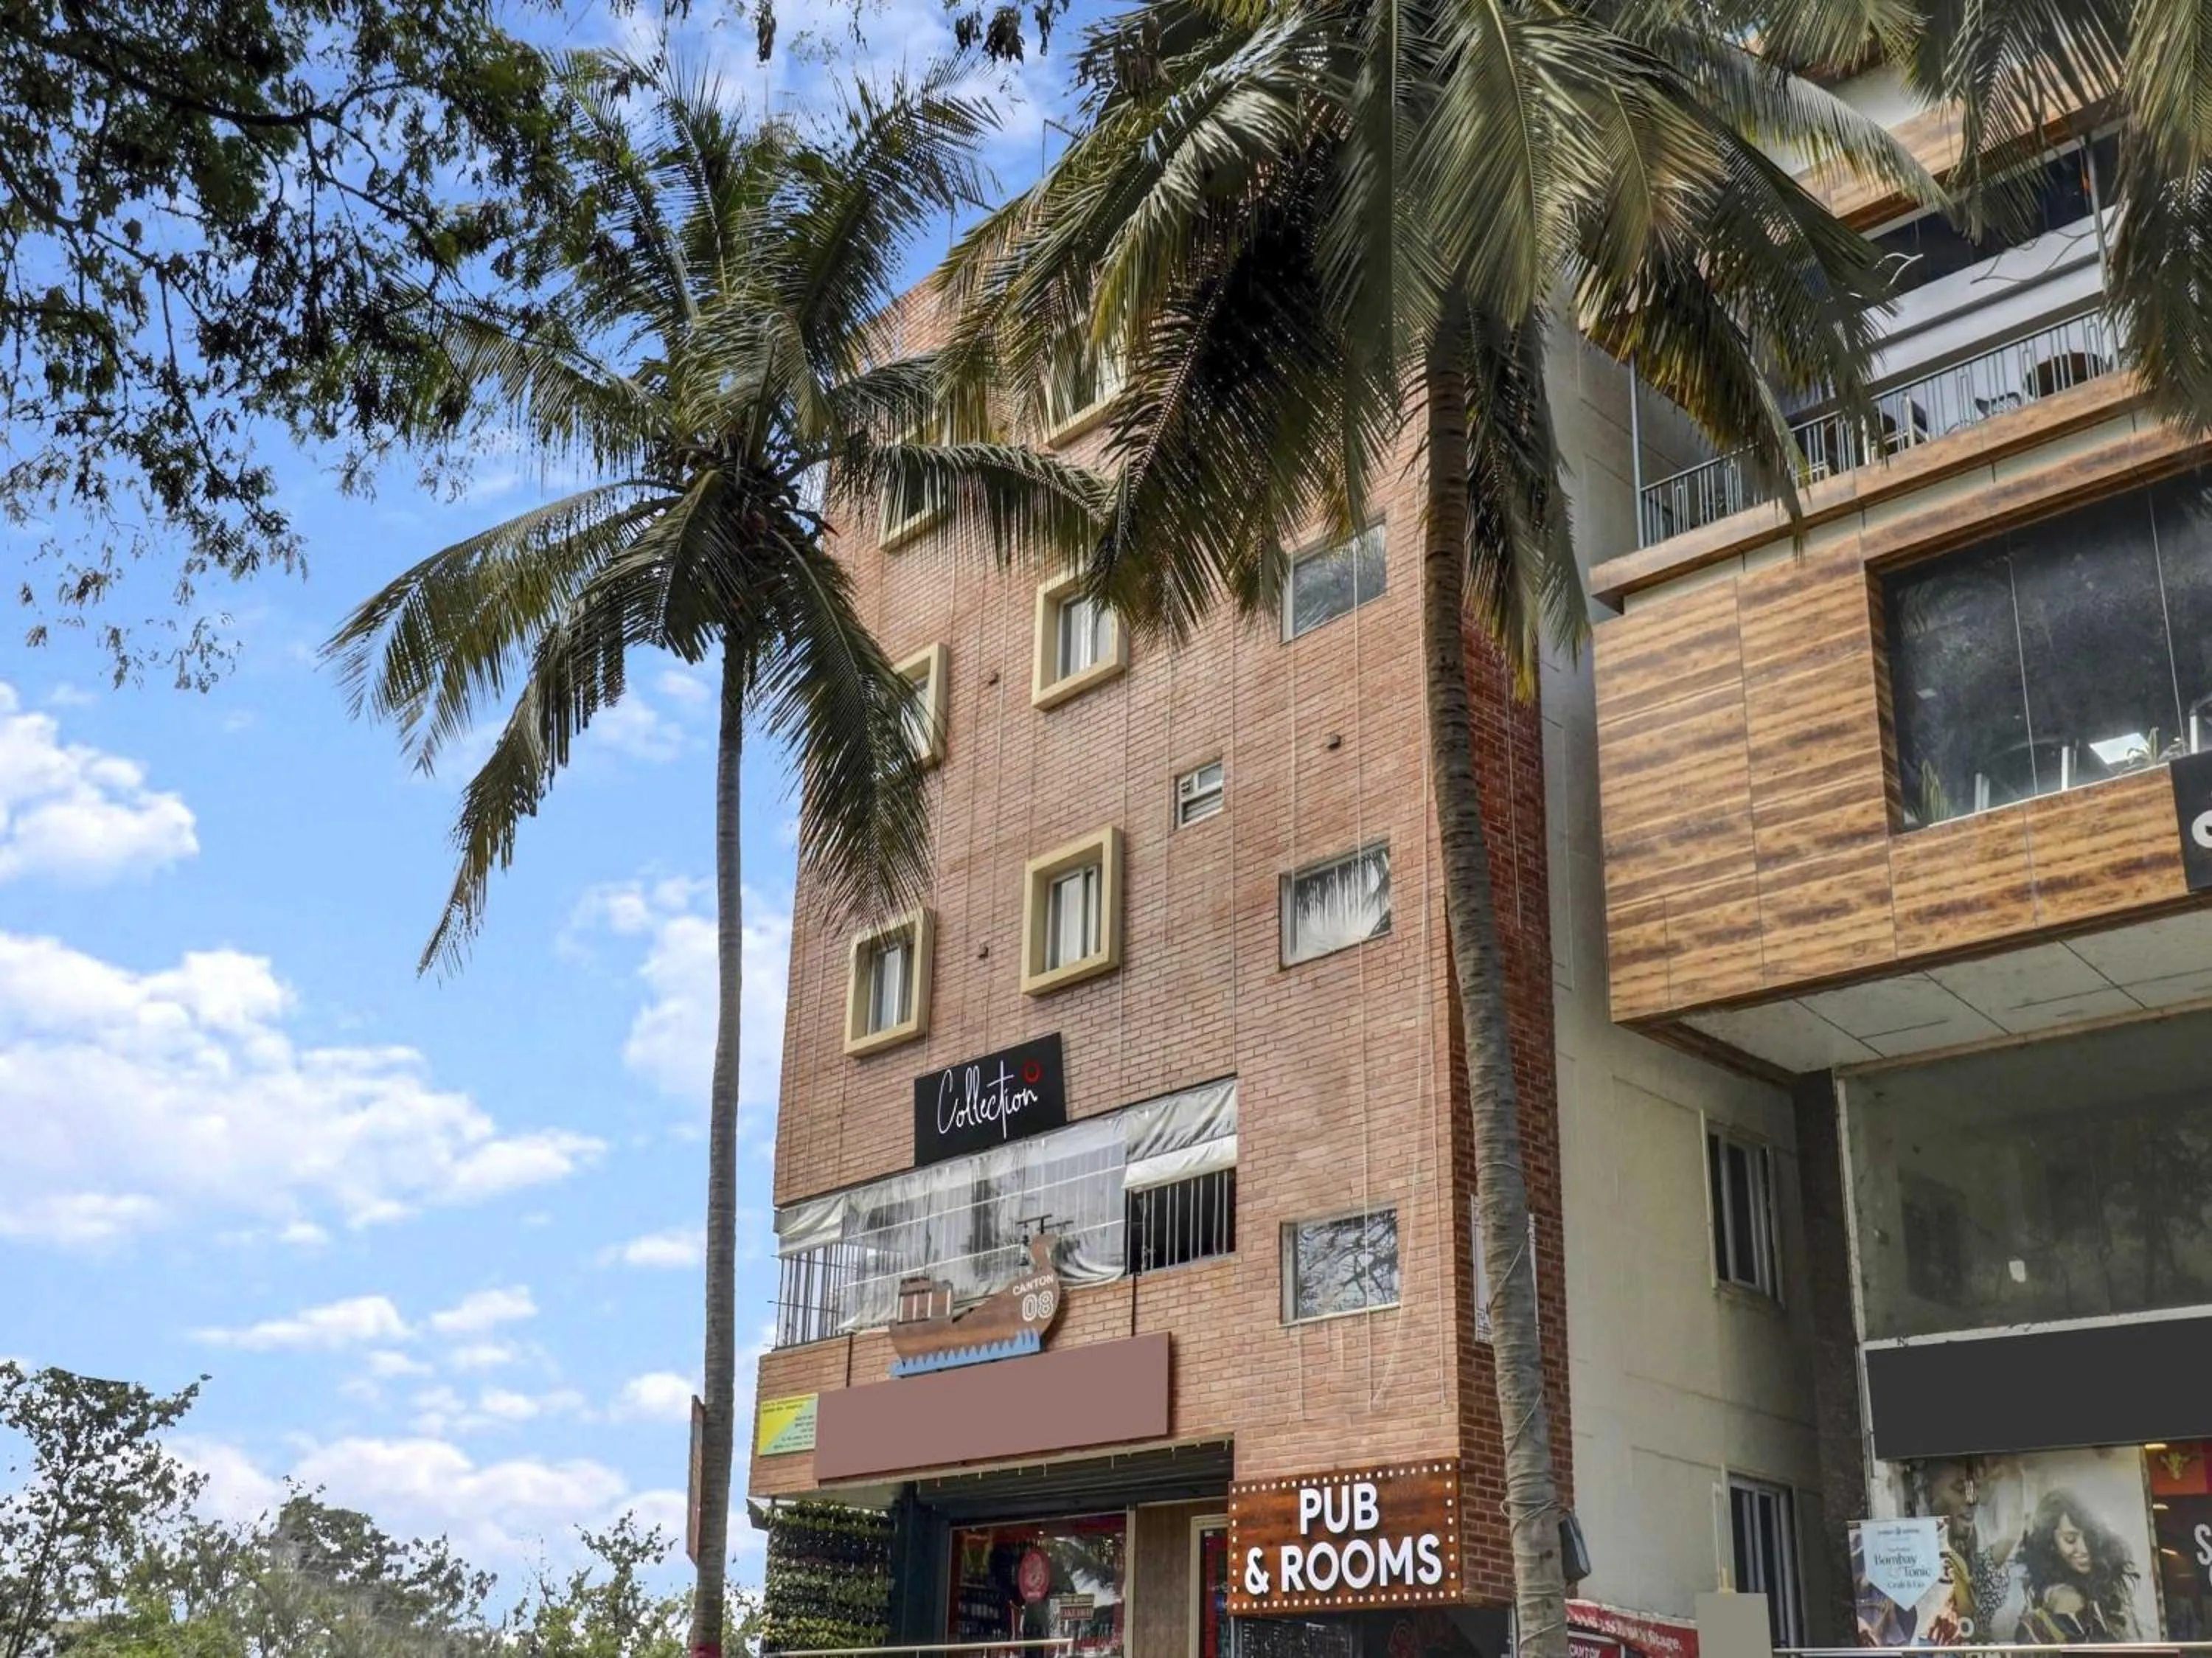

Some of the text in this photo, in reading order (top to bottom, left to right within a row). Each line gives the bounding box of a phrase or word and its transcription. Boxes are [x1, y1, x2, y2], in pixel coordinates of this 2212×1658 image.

[937, 1060, 1038, 1140] Collection
[1012, 1274, 1054, 1296] CANTON
[1022, 1291, 1054, 1322] 08
[1300, 1482, 1380, 1535] PUB
[1245, 1533, 1443, 1595] & ROOMS
[1874, 1553, 1917, 1567] Bombay
[1904, 1565, 1932, 1578] Tonic
